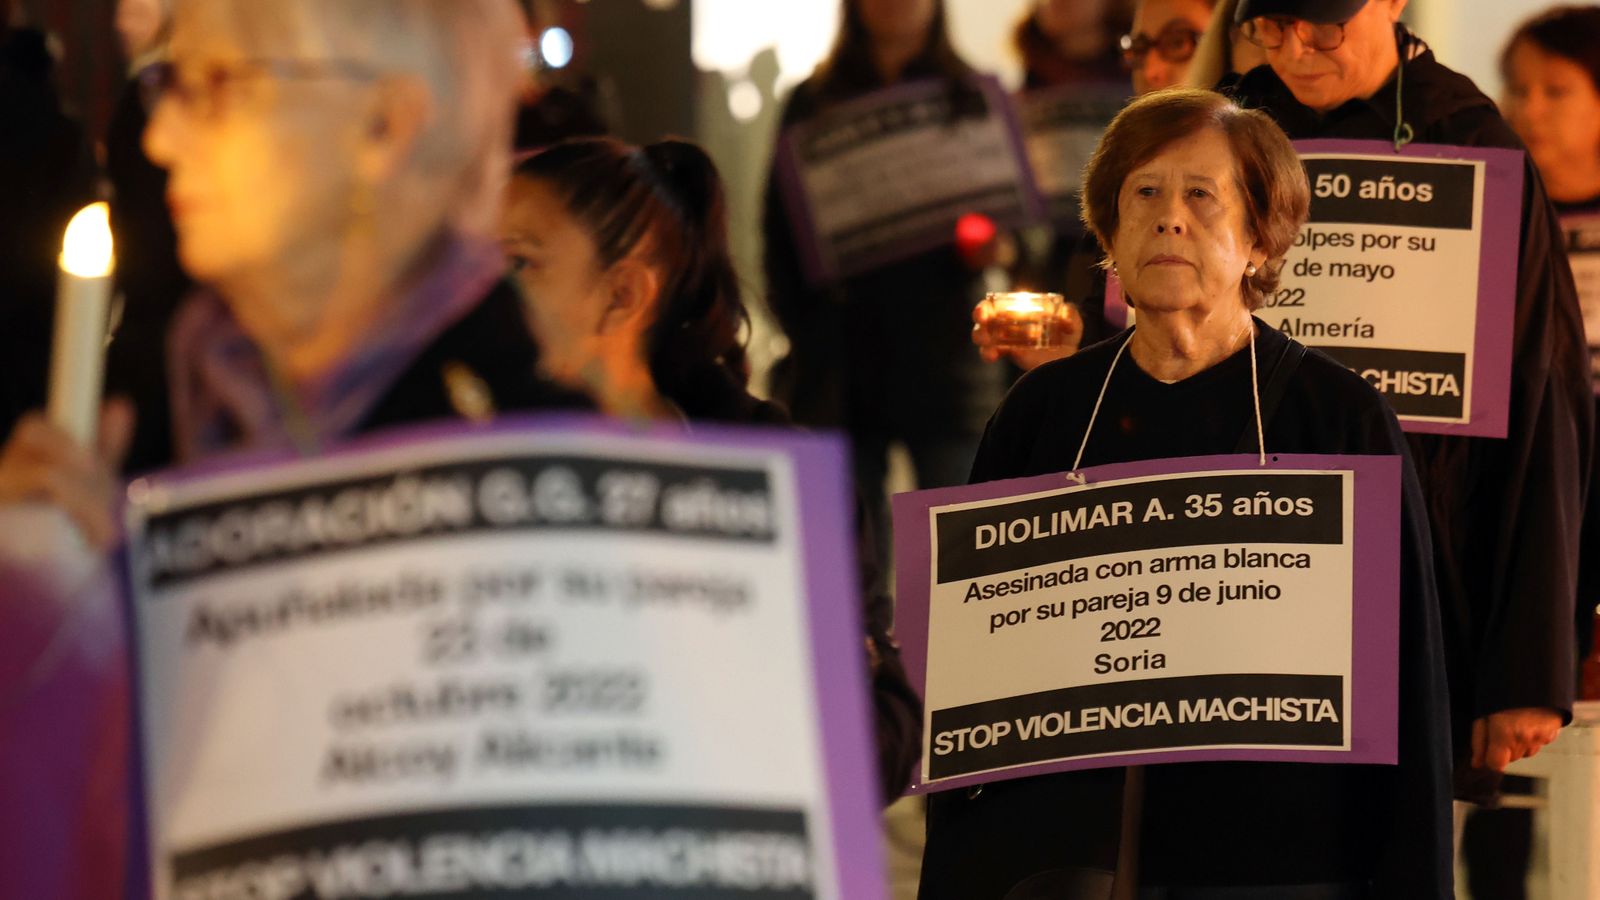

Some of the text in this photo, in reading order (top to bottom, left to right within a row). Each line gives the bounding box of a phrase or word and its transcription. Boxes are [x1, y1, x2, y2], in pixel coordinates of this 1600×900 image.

[1314, 174, 1434, 202] 50 años
[1293, 227, 1436, 252] olpes por su
[1293, 257, 1322, 277] de
[1329, 262, 1395, 283] mayo
[1279, 317, 1375, 339] Almería
[1359, 368, 1460, 397] CHISTA
[975, 491, 1314, 550] DIOLIMAR A. 35 años
[963, 547, 1311, 603] Asesinada con arma blanca
[989, 580, 1281, 634] por su pareja 9 de junio
[1100, 617, 1161, 643] 2022
[1094, 651, 1167, 675] Soria
[933, 696, 1339, 756] STOP VIOLENCIA MACHISTA
